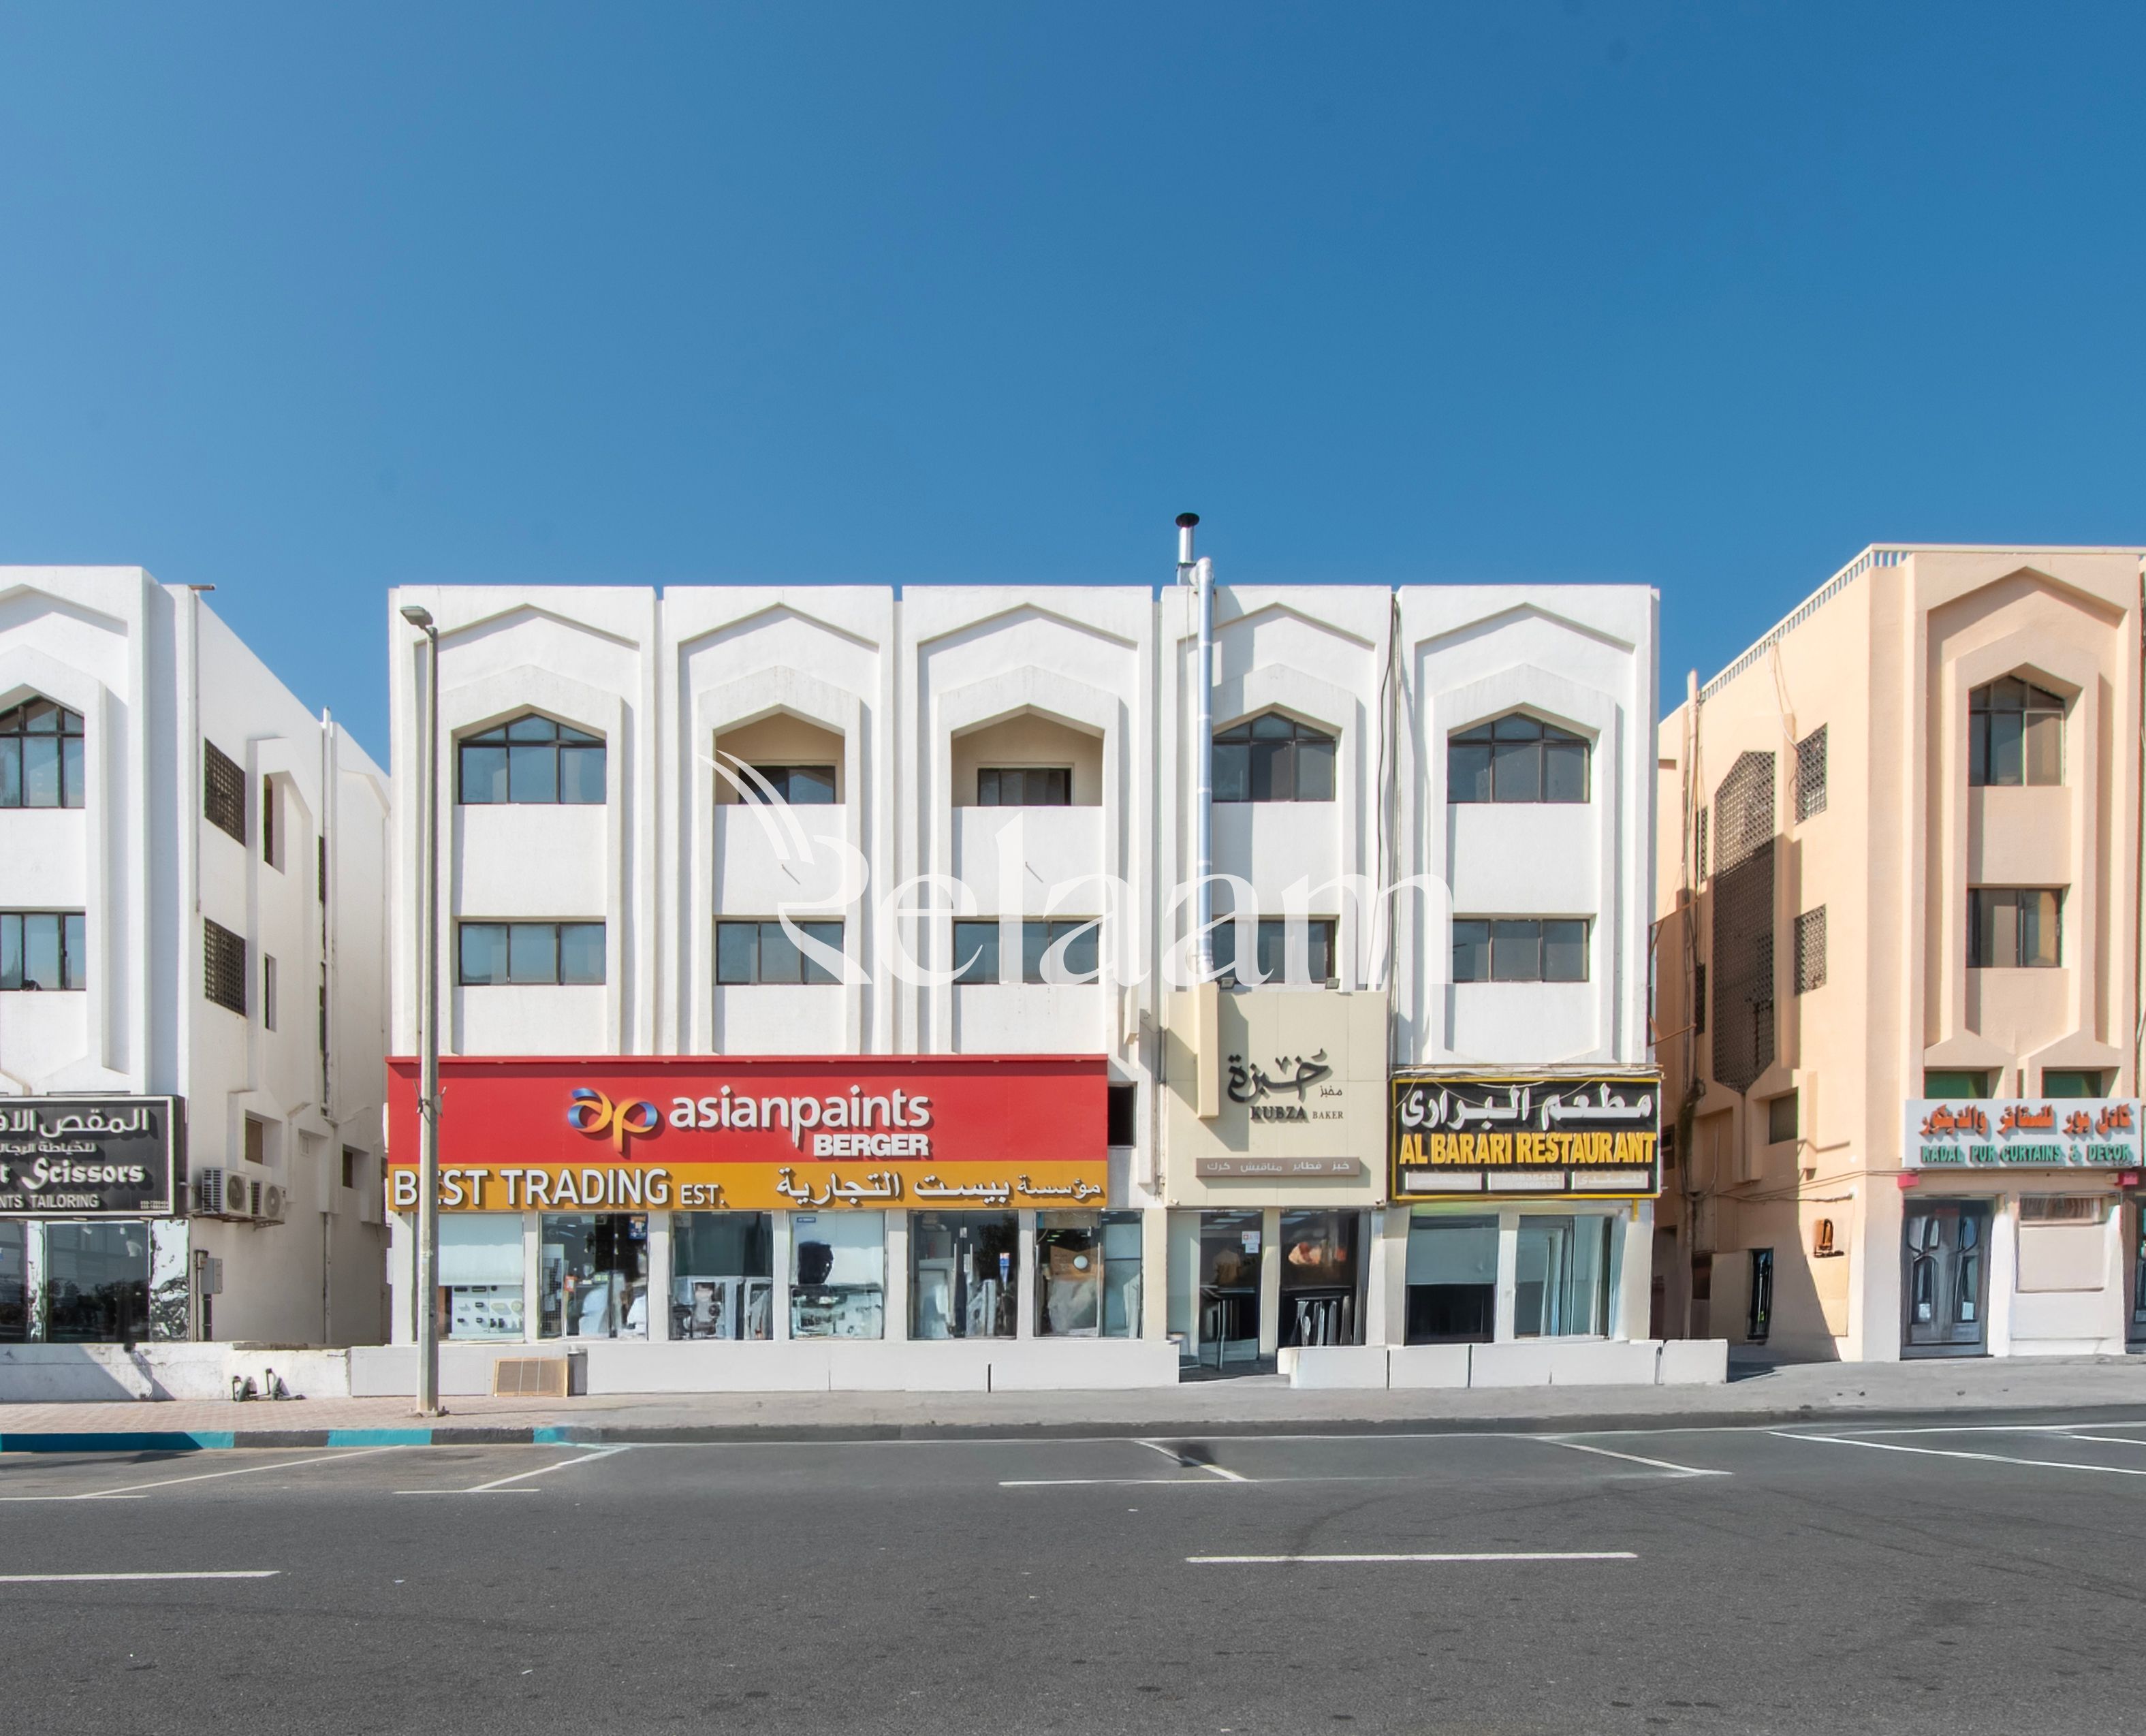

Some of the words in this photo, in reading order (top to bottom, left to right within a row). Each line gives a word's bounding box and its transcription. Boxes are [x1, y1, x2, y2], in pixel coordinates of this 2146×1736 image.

[669, 1085, 930, 1148] asianpaints
[1250, 1106, 1306, 1120] KUBZA
[1312, 1111, 1344, 1119] BAKER
[1541, 1082, 1652, 1131] مطعم
[40, 1108, 148, 1137] المقص
[813, 1133, 929, 1156] BERGER
[1400, 1133, 1427, 1164] AL
[1431, 1133, 1512, 1164] BARARI
[1516, 1132, 1657, 1164] RESTAURANT
[2001, 1144, 2061, 1162] CURTAINS
[2087, 1144, 2130, 1161] DECOR
[21, 1157, 145, 1190] Scissors
[394, 1169, 489, 1205] BST
[499, 1169, 669, 1205] TRADING
[680, 1184, 725, 1205] EST.
[776, 1167, 900, 1205] التجارية
[1017, 1173, 1101, 1200] مؤسسة
[29, 1194, 100, 1208] TAILORING
[914, 1174, 1010, 1203] بيست
